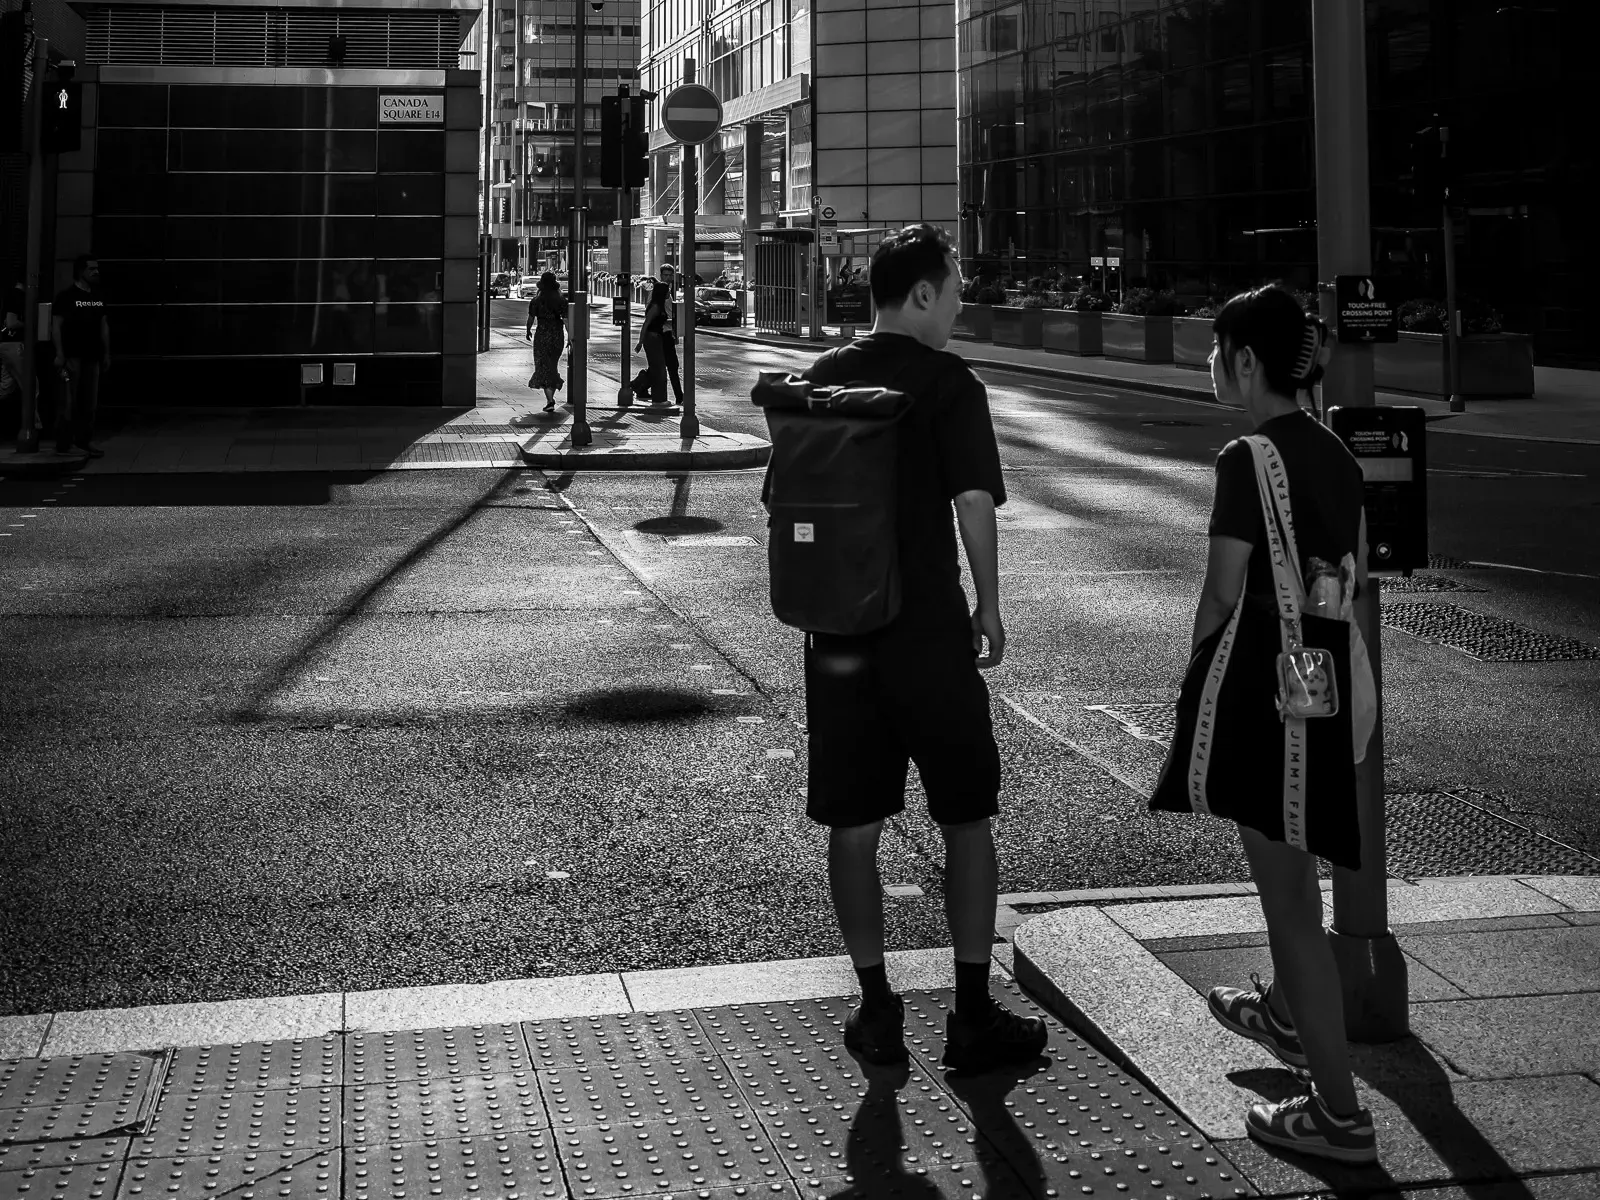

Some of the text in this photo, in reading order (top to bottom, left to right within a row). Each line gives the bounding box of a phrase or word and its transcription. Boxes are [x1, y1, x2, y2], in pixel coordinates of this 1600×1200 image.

[383, 98, 428, 107] CANADA
[383, 109, 440, 120] SQUARE E14
[1341, 309, 1373, 317] CROSSING
[1261, 442, 1288, 500] FAIRLY
[1196, 697, 1213, 760] FAIRLY
[1212, 629, 1233, 683] JIMMY
[1289, 730, 1300, 843] JIMMY FAIRL
